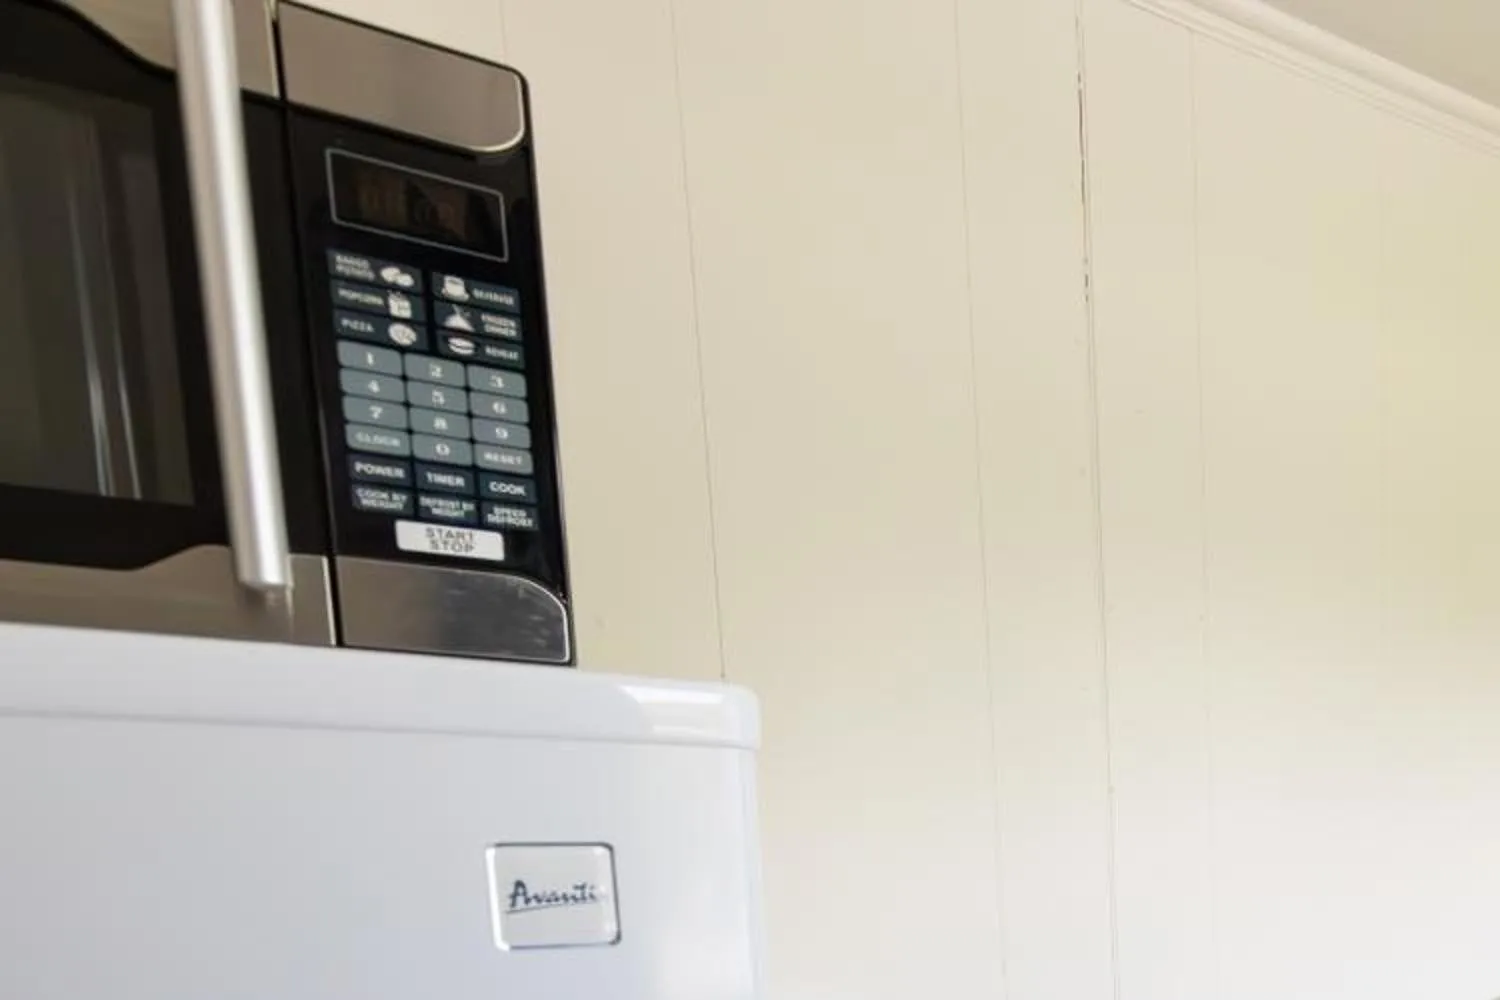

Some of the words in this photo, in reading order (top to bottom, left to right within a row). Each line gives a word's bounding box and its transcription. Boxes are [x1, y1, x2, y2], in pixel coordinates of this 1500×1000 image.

[340, 317, 374, 333] PIZZA
[366, 351, 375, 366] 1
[429, 363, 443, 378] 2
[367, 379, 380, 393] 4
[489, 374, 505, 389] 3
[431, 389, 445, 405] 5
[368, 405, 383, 419] 7
[492, 400, 507, 414] 6
[433, 417, 448, 430] 8
[354, 431, 401, 447] CLOCK
[495, 427, 508, 440] 9
[435, 443, 450, 456] 0
[483, 451, 523, 466] RESET
[354, 461, 406, 479] POWER
[426, 471, 465, 487] TIMER
[356, 487, 390, 500] COOK
[488, 481, 527, 497] COOK
[425, 526, 475, 542] START
[429, 538, 476, 554] STOP
[508, 879, 598, 909] Avanti
